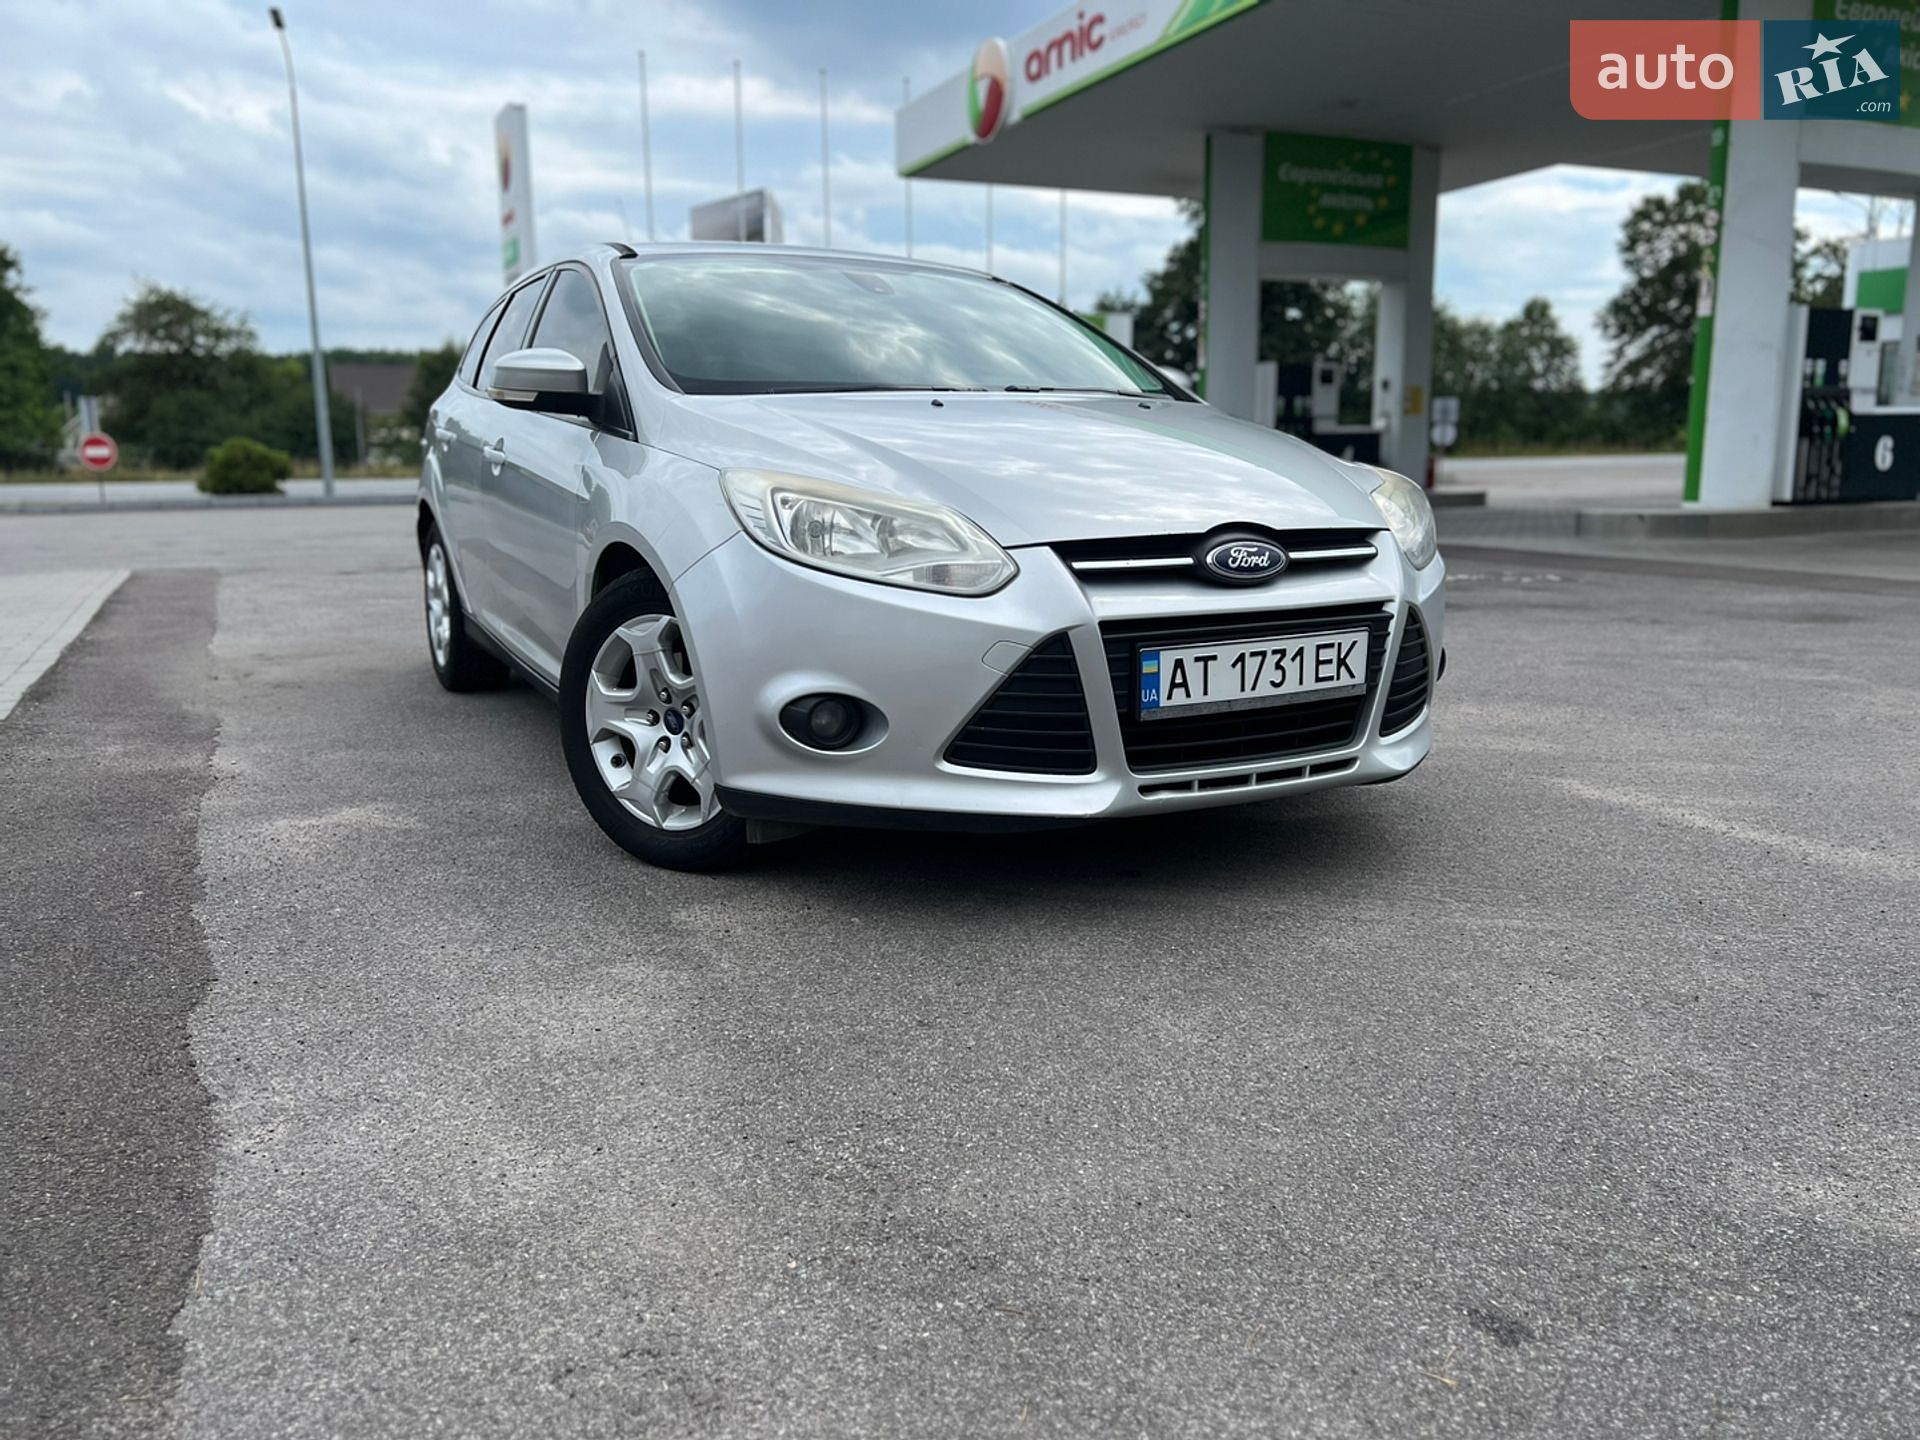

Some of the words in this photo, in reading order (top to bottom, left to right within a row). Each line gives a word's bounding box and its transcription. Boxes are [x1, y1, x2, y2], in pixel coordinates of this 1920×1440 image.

[1024, 10, 1106, 83] amic
[1874, 434, 1895, 472] 6
[1228, 546, 1271, 569] Ford
[1166, 654, 1218, 701] AT
[1231, 646, 1304, 692] 1731
[1314, 640, 1359, 683] EK
[1141, 688, 1159, 703] UA
